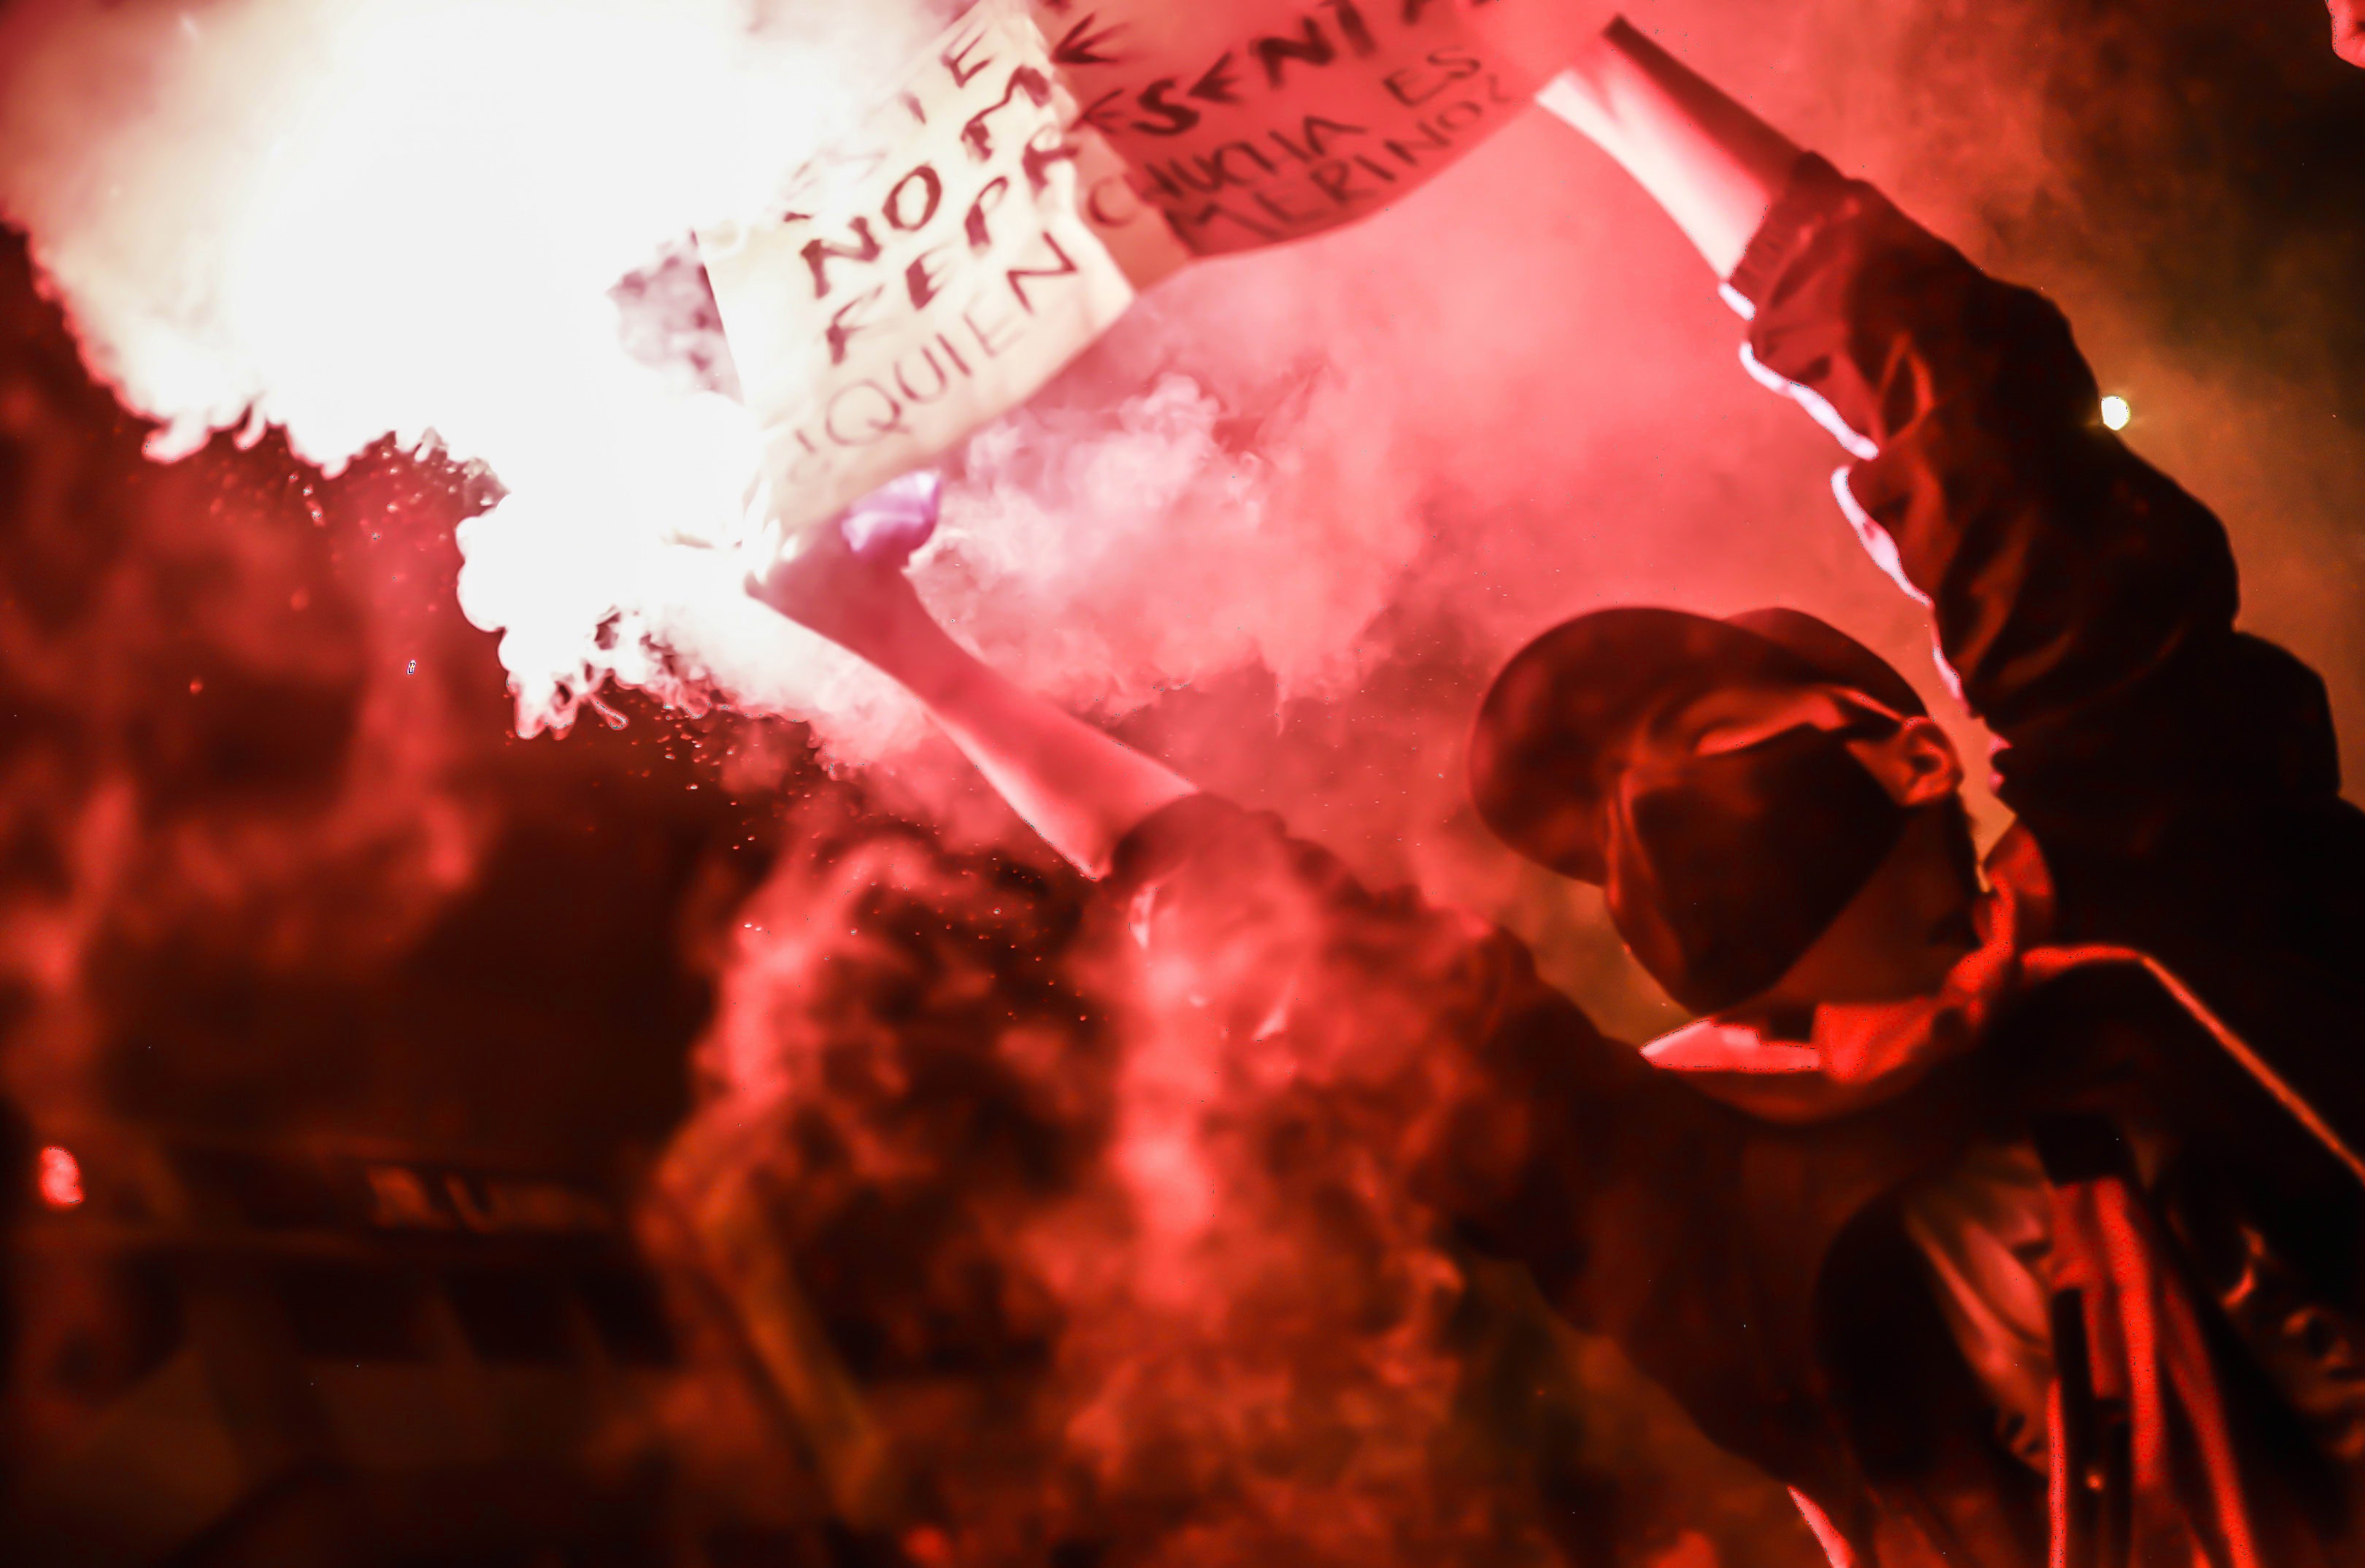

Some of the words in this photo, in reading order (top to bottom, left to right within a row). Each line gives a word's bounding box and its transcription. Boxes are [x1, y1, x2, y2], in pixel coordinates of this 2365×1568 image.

[799, 162, 943, 301] NO
[959, 12, 1131, 164] ME
[823, 0, 1492, 366] REPRESENT
[1382, 45, 1480, 107] ES
